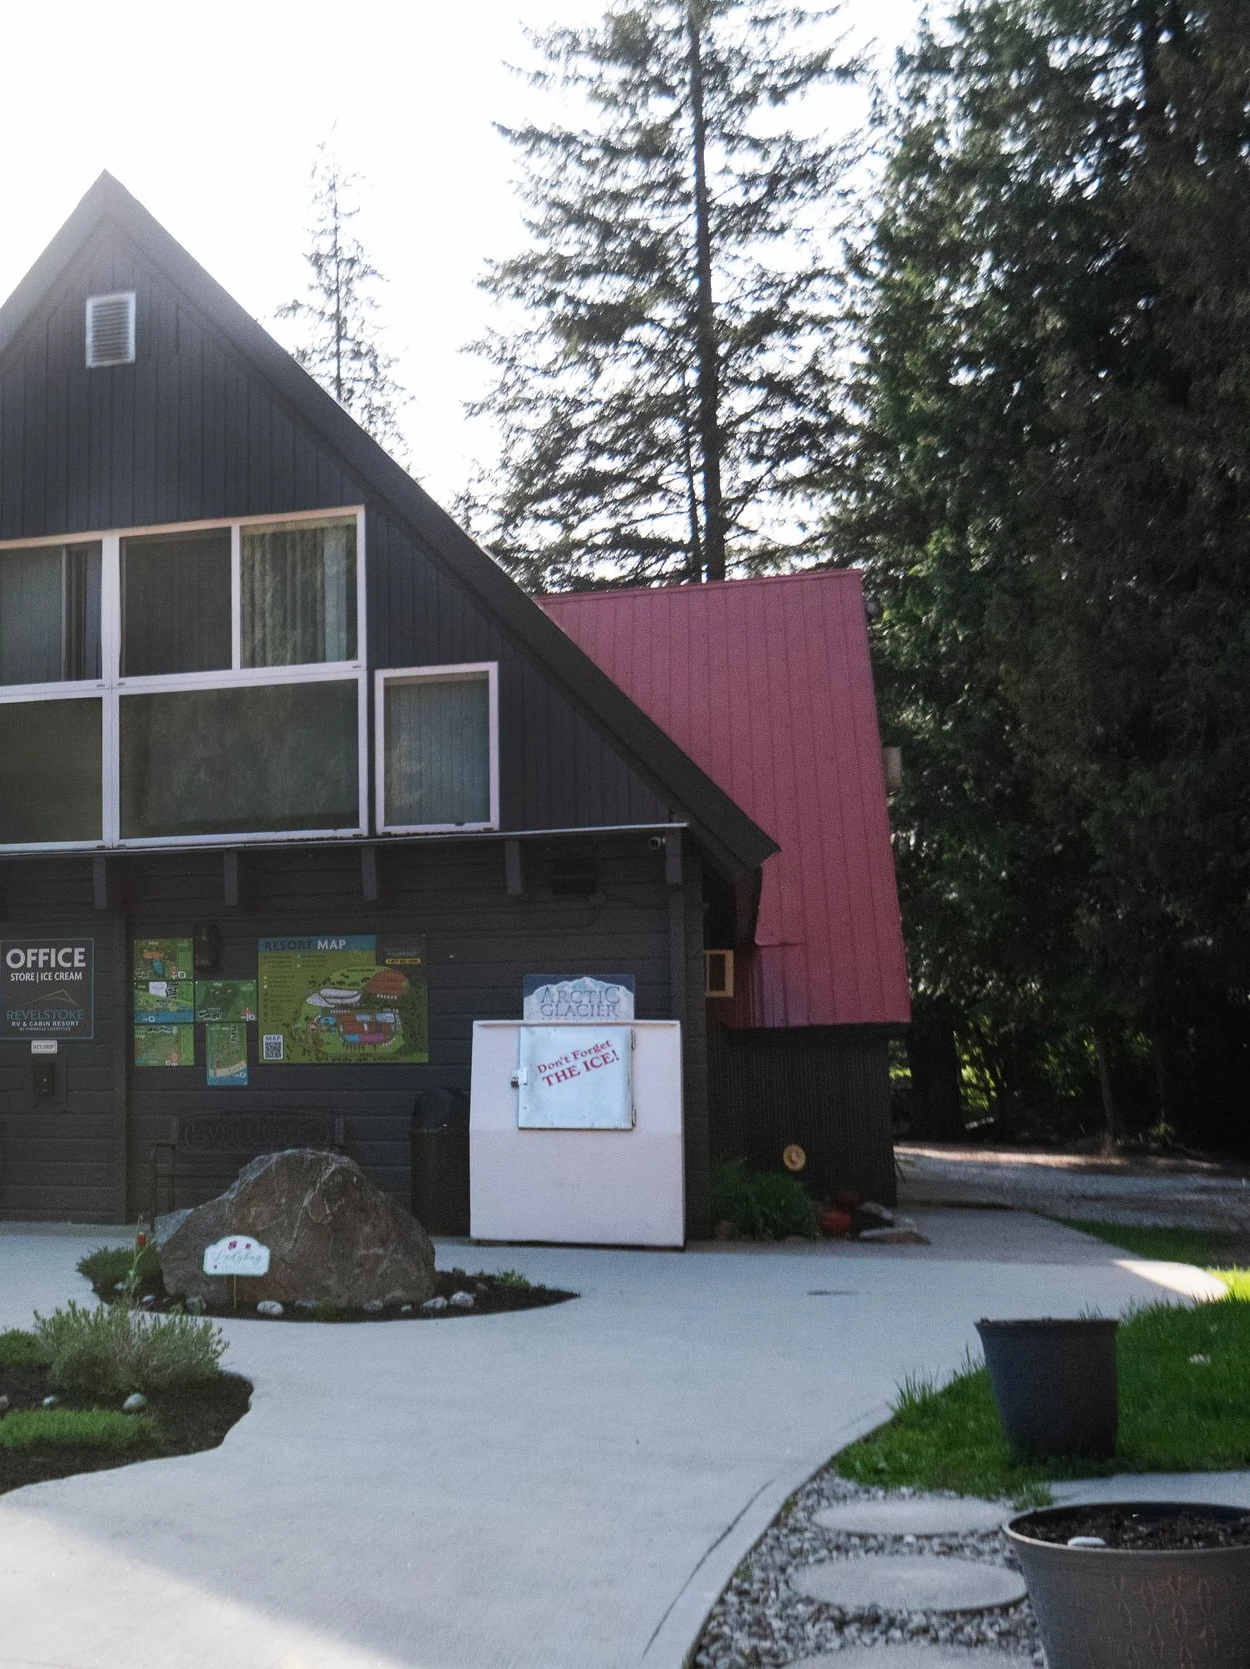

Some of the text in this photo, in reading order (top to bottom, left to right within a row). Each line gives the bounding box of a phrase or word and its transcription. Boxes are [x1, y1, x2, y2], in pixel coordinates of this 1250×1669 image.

[265, 939, 347, 951] RESORT MAP
[6, 947, 86, 969] OFFICE
[10, 972, 83, 982] STORE ICE CREAM
[540, 986, 620, 1004] ARCTIC
[6, 1009, 85, 1020] REVELSTOKE
[540, 1004, 621, 1017] GLACIER
[537, 1040, 612, 1074] Don't Forget
[542, 1049, 620, 1087] THE ICE!
[211, 1248, 262, 1266] Ladybug
